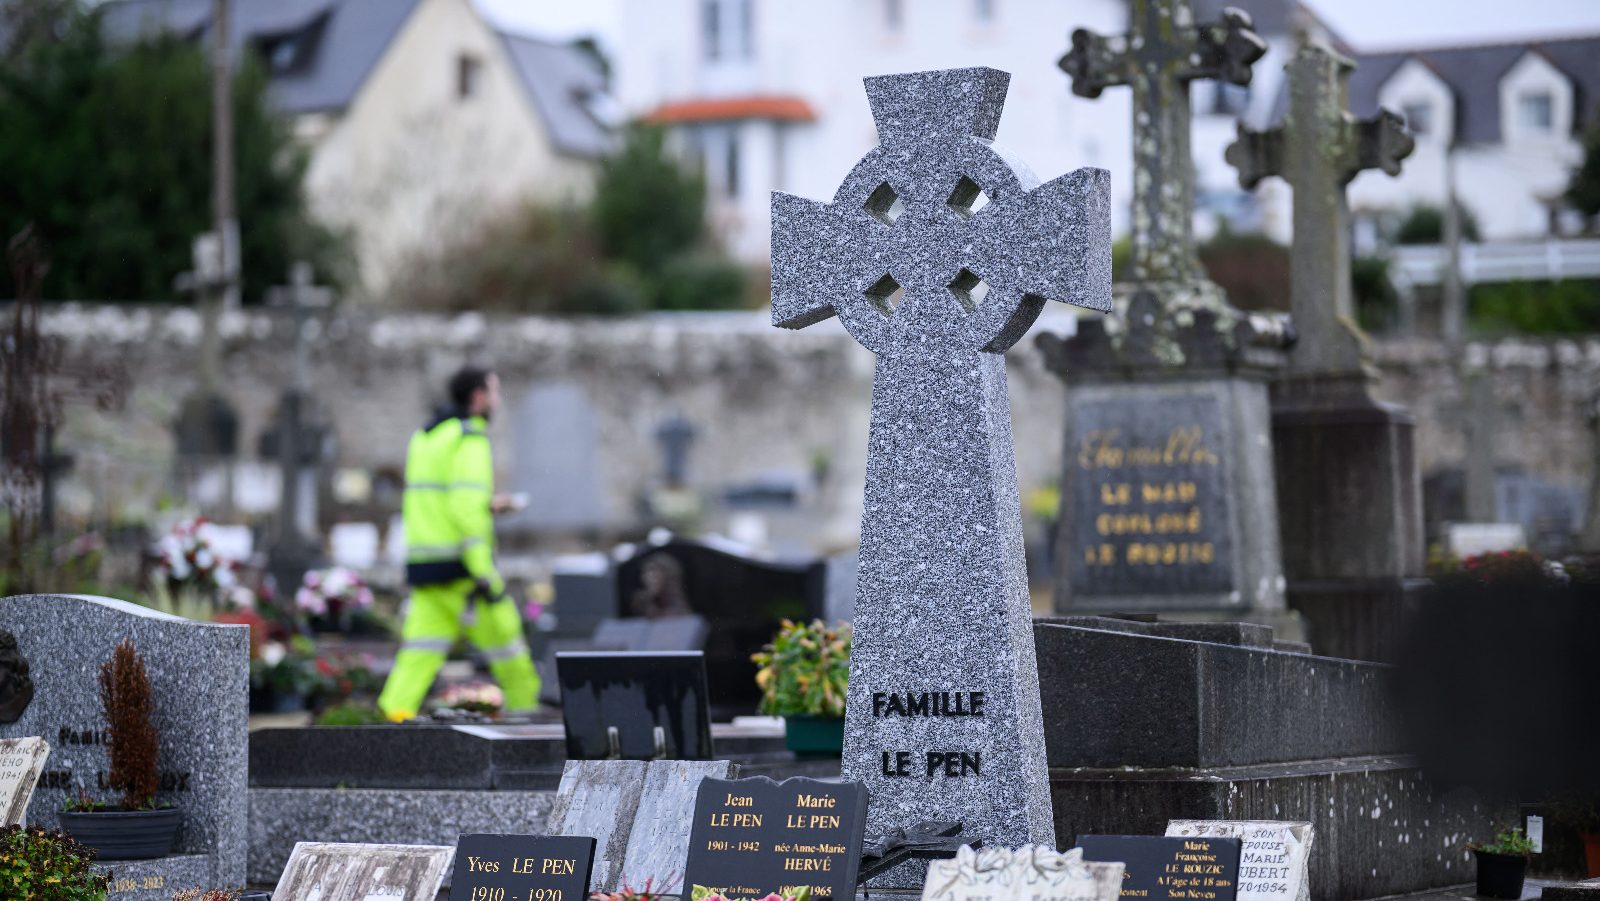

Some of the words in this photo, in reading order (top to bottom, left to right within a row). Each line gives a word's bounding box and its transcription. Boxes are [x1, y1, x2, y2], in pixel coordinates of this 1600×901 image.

[873, 691, 983, 717] FAMILLE
[882, 751, 910, 776] LE
[927, 751, 980, 777] PEN
[724, 793, 753, 807] Jean
[796, 794, 836, 808] Marie
[710, 813, 730, 827] LE
[733, 814, 763, 827] PEN
[786, 815, 806, 828] LE
[810, 815, 840, 829] PEN
[1252, 829, 1276, 839] SON
[707, 841, 728, 851] 1901
[737, 841, 760, 851] 1942
[774, 842, 790, 852] née
[792, 843, 846, 854] Anne-Marie
[1183, 841, 1210, 851] Marie
[784, 856, 832, 871] HERVÉ
[1175, 852, 1217, 864] Françoise
[1243, 853, 1286, 864] MARIE
[467, 856, 500, 873] Yves
[512, 857, 534, 874] LE
[542, 858, 576, 875] PEN
[1165, 864, 1179, 873] LE
[1183, 865, 1224, 874] ROUZIC
[1239, 866, 1290, 879] UBERT
[1189, 877, 1201, 886] de
[1203, 877, 1214, 886] 18
[1215, 879, 1231, 887] ans
[471, 886, 505, 901] 1910
[529, 888, 562, 901] 1920
[737, 885, 761, 894] France
[809, 885, 832, 896] 1965
[1168, 889, 1186, 898] Son
